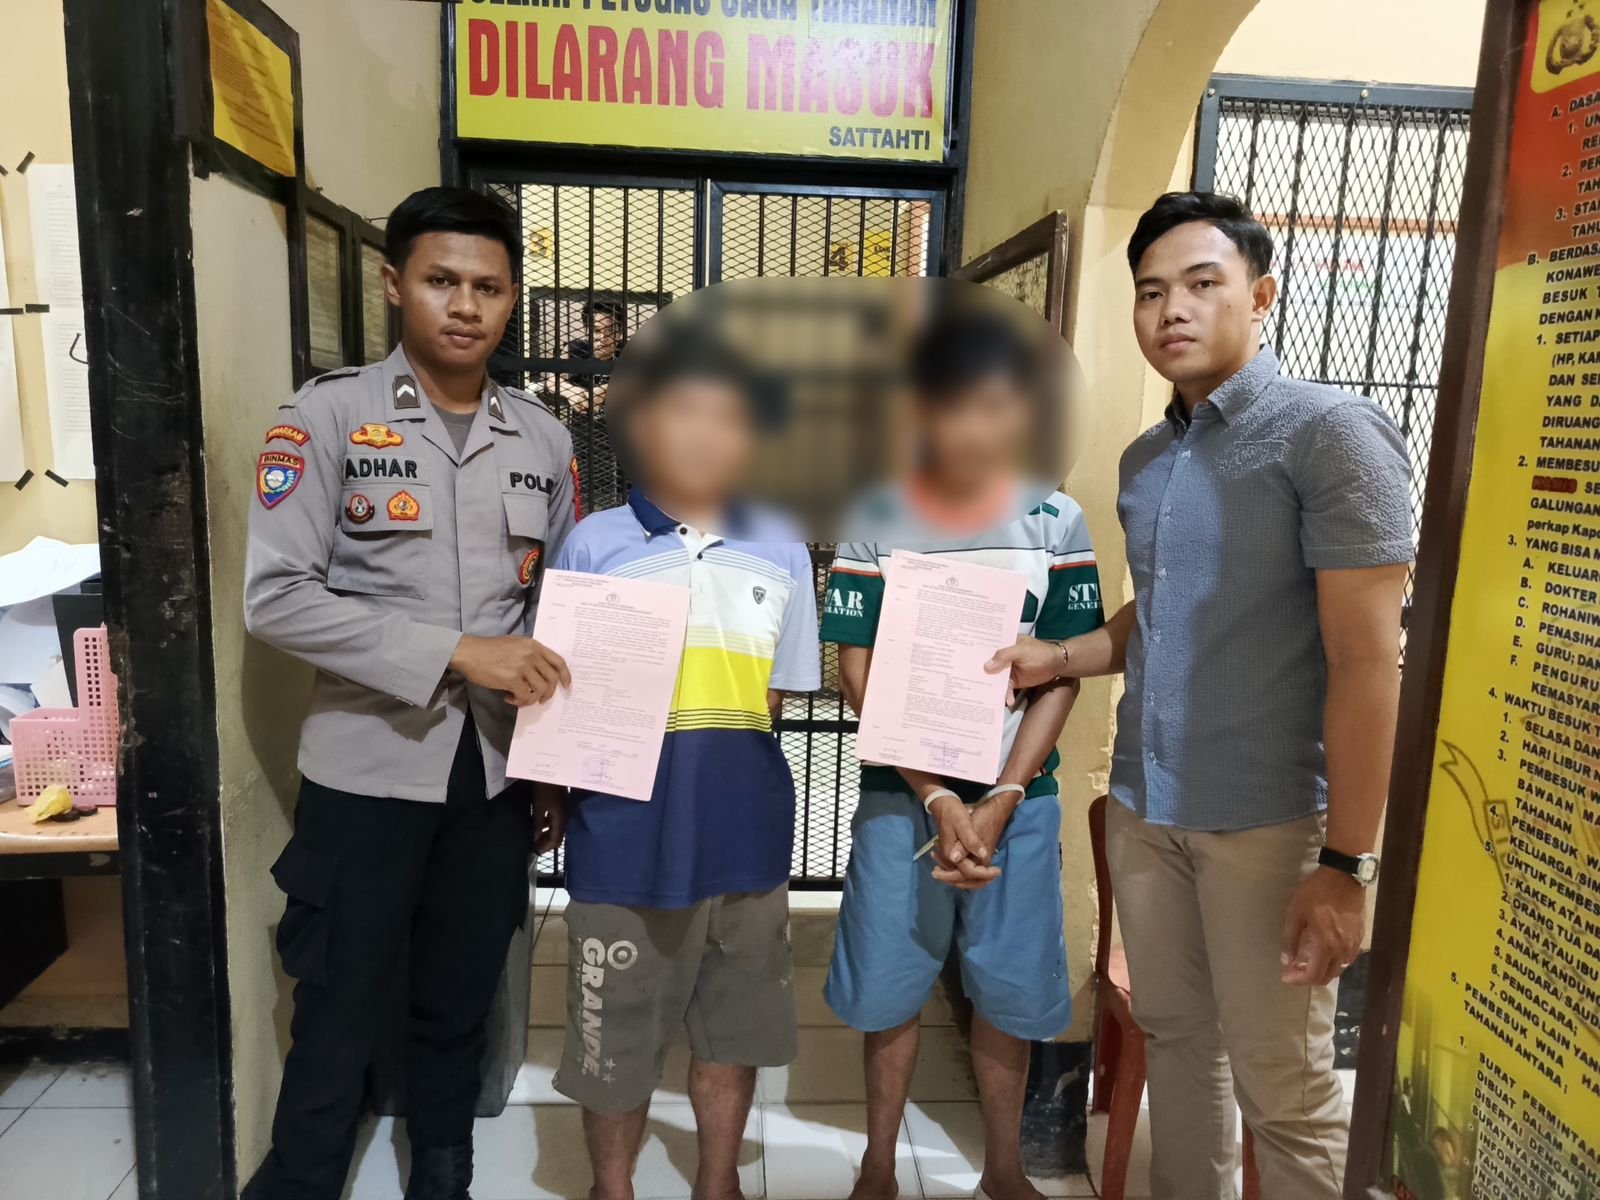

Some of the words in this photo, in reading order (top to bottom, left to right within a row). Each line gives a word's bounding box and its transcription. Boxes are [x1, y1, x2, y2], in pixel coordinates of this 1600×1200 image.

[468, 18, 725, 109] DILARANG
[746, 33, 936, 120] MASUK
[1551, 106, 1561, 118] A.
[829, 126, 930, 151] SATTAHTI
[1562, 164, 1571, 178] 2.
[1556, 207, 1566, 220] 3.
[1574, 197, 1600, 217] STA
[1527, 253, 1540, 266] B.
[1549, 242, 1600, 263] BERDAS
[1542, 287, 1588, 304] BESUK
[1538, 308, 1593, 325] DENGAN
[1536, 333, 1547, 345] 1.
[1555, 329, 1600, 345] SETIAP
[1551, 352, 1575, 368] (HP,
[1548, 373, 1576, 386] DAN
[1581, 372, 1600, 386] SE
[1546, 394, 1582, 407] YANG
[264, 455, 298, 466] BINMAS
[345, 458, 417, 479] ADHAR
[1517, 455, 1528, 467] 2.
[1527, 519, 1570, 536] perkap
[1507, 534, 1517, 546] 3.
[1525, 536, 1559, 553] YANG
[1560, 542, 1591, 559] BISA
[1523, 556, 1534, 570] A.
[1547, 561, 1600, 582] KELUAR
[1068, 583, 1099, 602] ST
[1518, 595, 1529, 609] C.
[1520, 576, 1532, 589] B.
[1544, 581, 1597, 604] DOKTER
[1515, 615, 1526, 628] D.
[1510, 654, 1518, 667] F.
[1512, 635, 1523, 648] E.
[1536, 642, 1575, 665] GURU;
[1488, 686, 1498, 699] 4.
[1504, 691, 1546, 717] WAKTU
[1548, 707, 1592, 734] BESUK
[1531, 681, 1600, 716] KEMASYAR
[1503, 711, 1512, 724] 1.
[1524, 720, 1571, 748] SELASA
[1499, 730, 1509, 743] 2.
[1522, 738, 1551, 761] HARI
[1553, 751, 1592, 779] LIBUR
[1497, 748, 1507, 762] 3.
[1519, 757, 1587, 799] PEMBESUK
[1517, 777, 1574, 814] BAWAAN
[1489, 804, 1499, 818] 4.
[1511, 815, 1578, 859] PEMBESUK
[1515, 796, 1572, 834] TAHANAN
[1484, 840, 1494, 855] 5.
[1506, 853, 1548, 885] UNTUK
[1509, 834, 1573, 879] KELUARGA
[1504, 872, 1513, 886] 1.
[1515, 878, 1557, 912] KAKEK
[1501, 890, 1511, 904] 2.
[1512, 898, 1554, 931] ORANG
[1557, 924, 1582, 950] TUA
[1496, 927, 1505, 941] 4.
[1507, 935, 1540, 964] ANAK
[1499, 908, 1508, 923] 3.
[1509, 916, 1540, 944] AYAH
[1542, 937, 1574, 965] ATAU
[1576, 959, 1599, 982] IBU
[1491, 963, 1500, 977] 6.
[1502, 971, 1577, 1037] PENGACARA;
[1493, 945, 1503, 959] 5.
[1564, 995, 1600, 1030] SAUD
[581, 937, 605, 1077] GRANDE
[1450, 971, 1459, 984] 5.
[1465, 983, 1528, 1039] PEMBESUK
[1535, 1036, 1564, 1069] WNA
[1463, 1000, 1514, 1048] TAHANAN
[1515, 1043, 1562, 1088] ANTARA
[1489, 981, 1498, 995] 7.
[1499, 990, 1540, 1027] ORANG
[1541, 1021, 1570, 1050] LAIN
[1574, 1043, 1600, 1075] YAN
[1479, 1052, 1516, 1089] SURAT
[1477, 1069, 1517, 1109] DIBUAT
[1522, 1110, 1563, 1152] DALAM
[1472, 1105, 1528, 1164] SURATNYA
[1474, 1087, 1523, 1138] DISERTAI
[1529, 1137, 1580, 1190] DENGAN
[1479, 1131, 1540, 1196] INFORMASI
